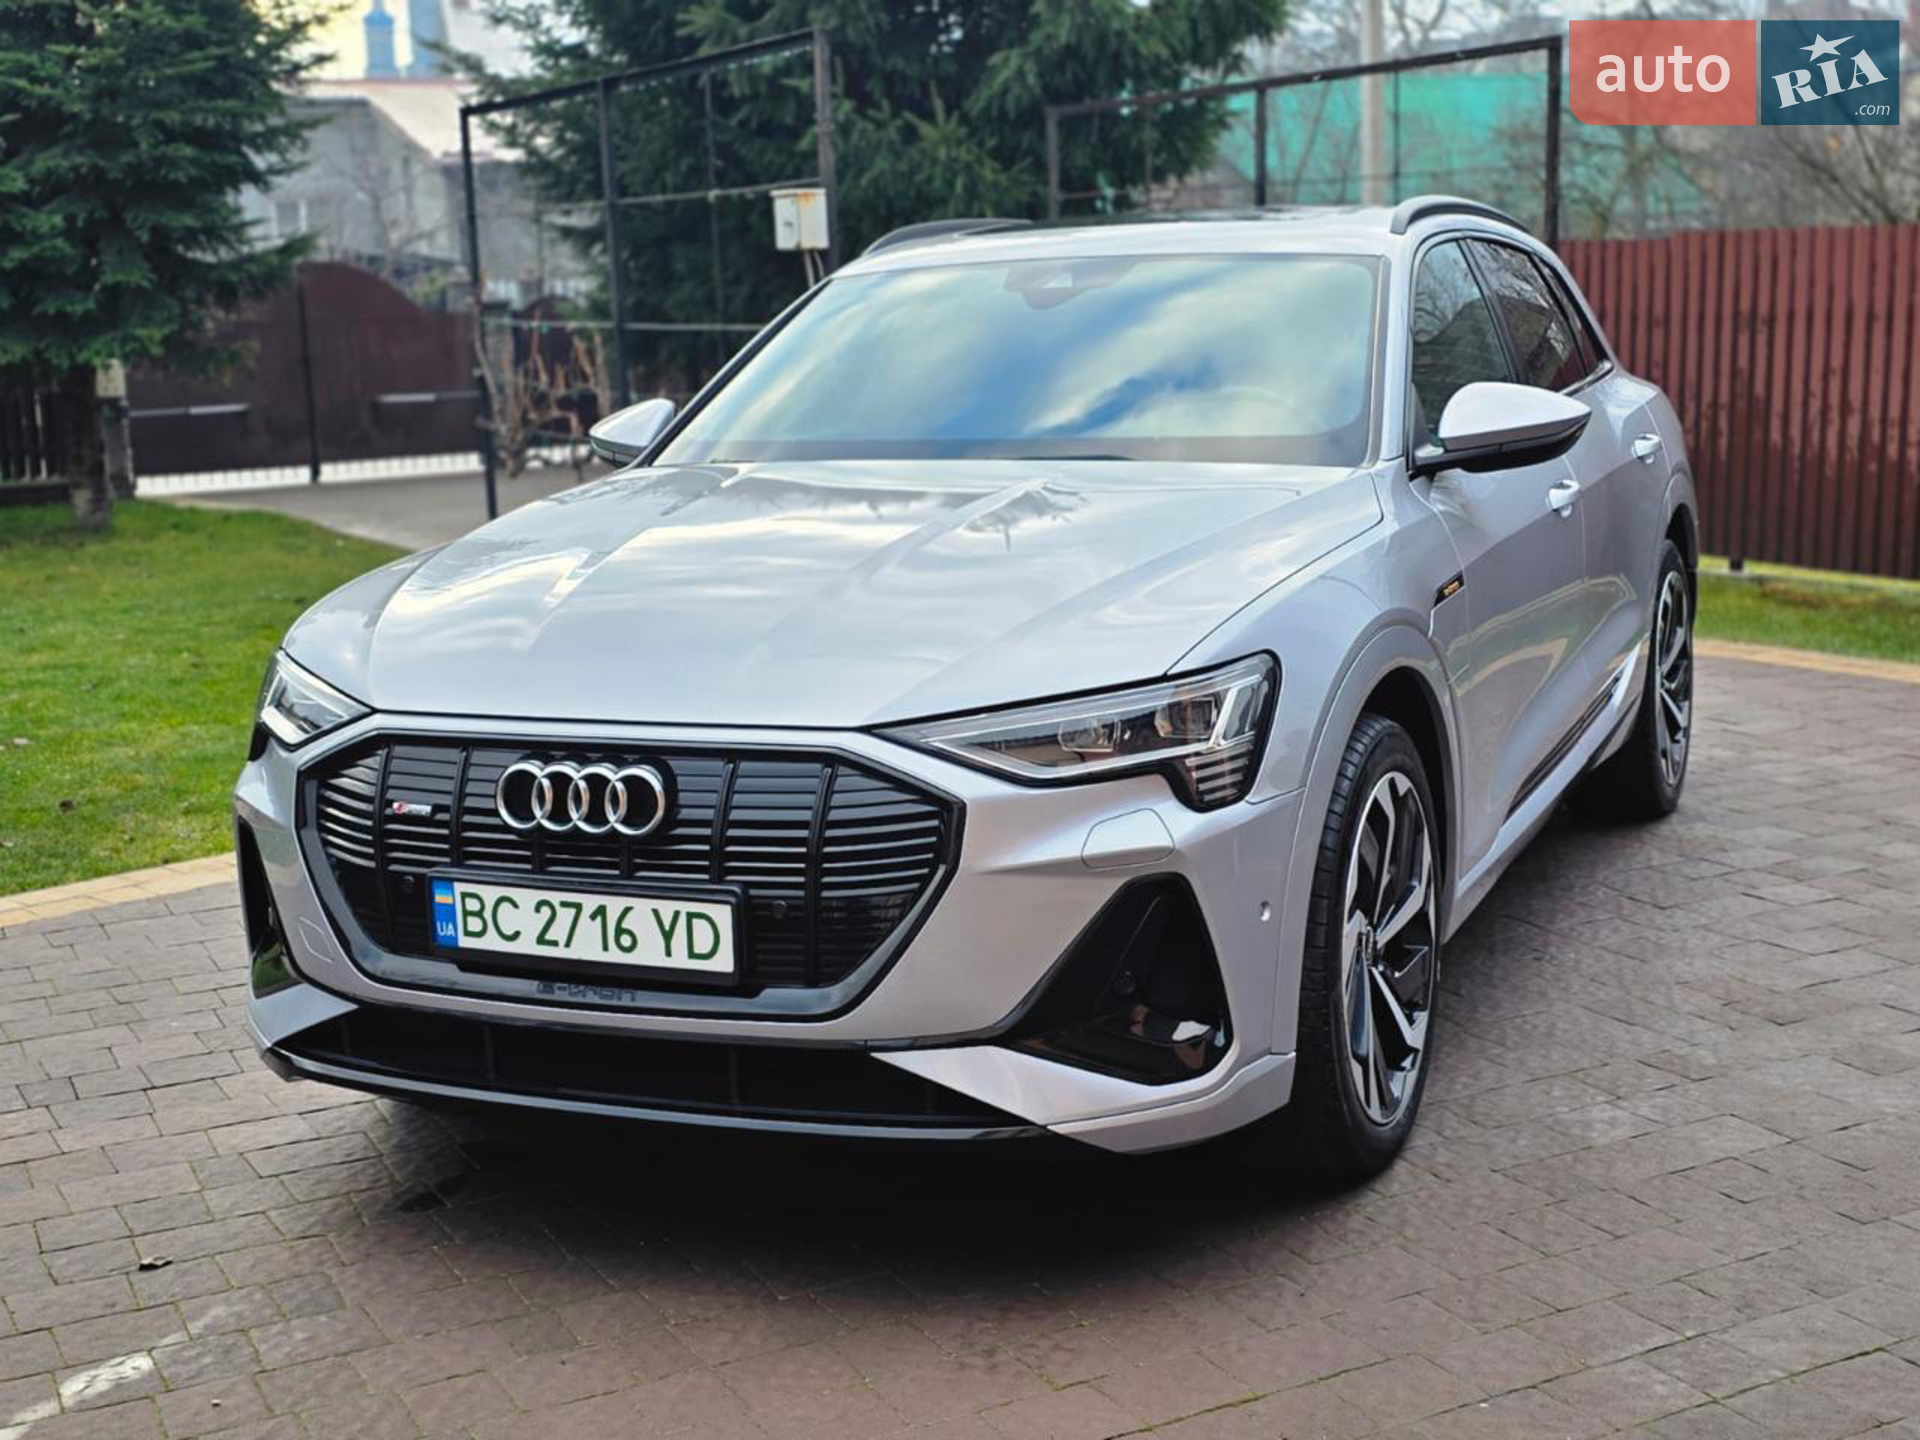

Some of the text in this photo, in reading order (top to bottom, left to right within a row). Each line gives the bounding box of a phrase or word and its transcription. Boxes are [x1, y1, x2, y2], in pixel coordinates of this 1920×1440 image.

[437, 922, 455, 936] UA
[459, 891, 721, 961] BC 2716 YD
